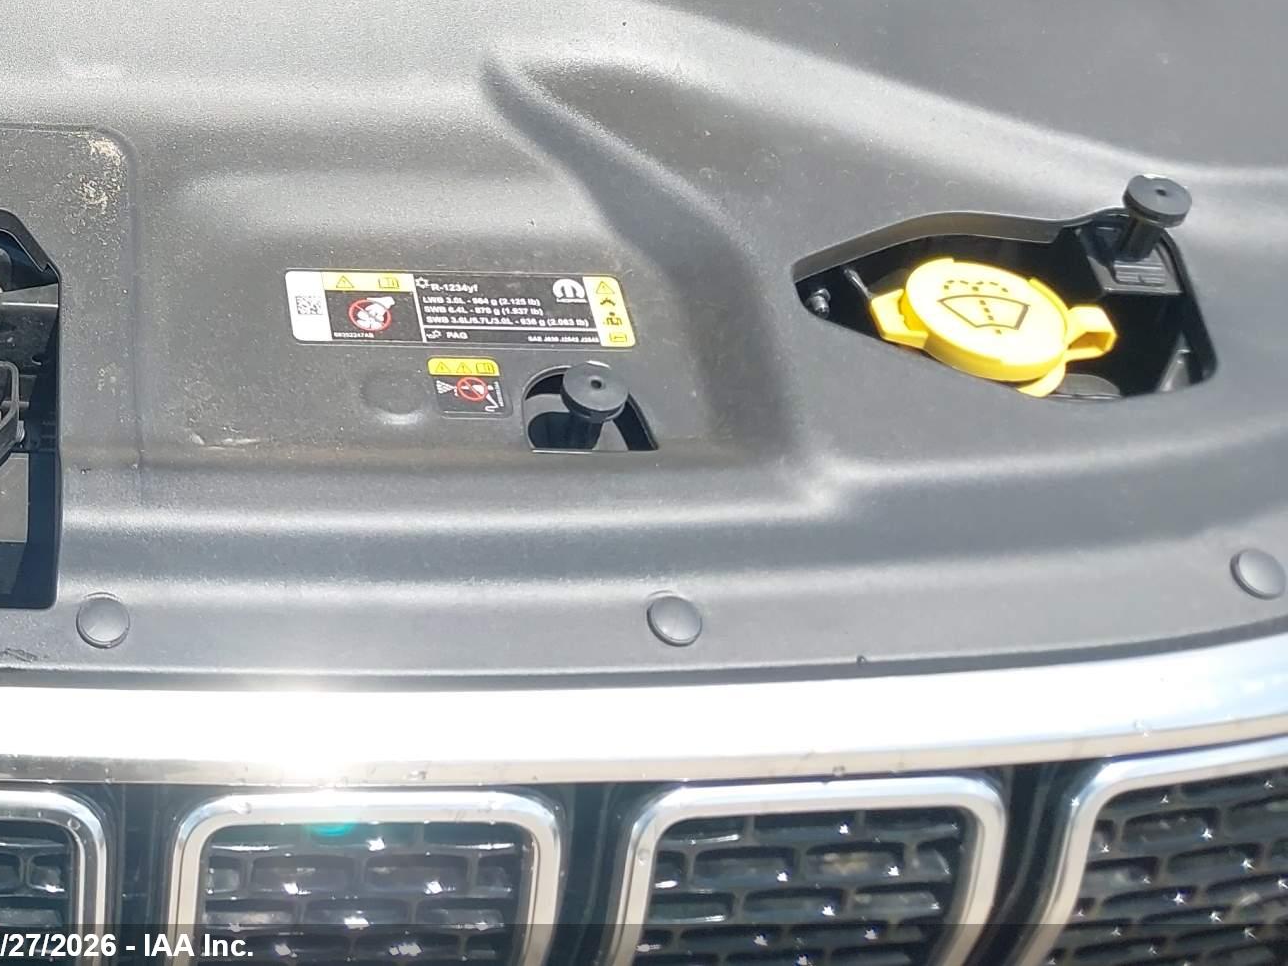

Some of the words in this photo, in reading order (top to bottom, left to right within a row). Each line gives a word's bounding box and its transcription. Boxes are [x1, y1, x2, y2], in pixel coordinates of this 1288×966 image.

[431, 284, 478, 293] R-1234yf
[422, 296, 445, 304] LWB
[490, 298, 498, 306] g
[527, 298, 541, 306] lb)
[493, 308, 500, 316] g
[530, 308, 544, 316] lb)
[426, 316, 449, 324] SWB
[538, 319, 546, 327] g
